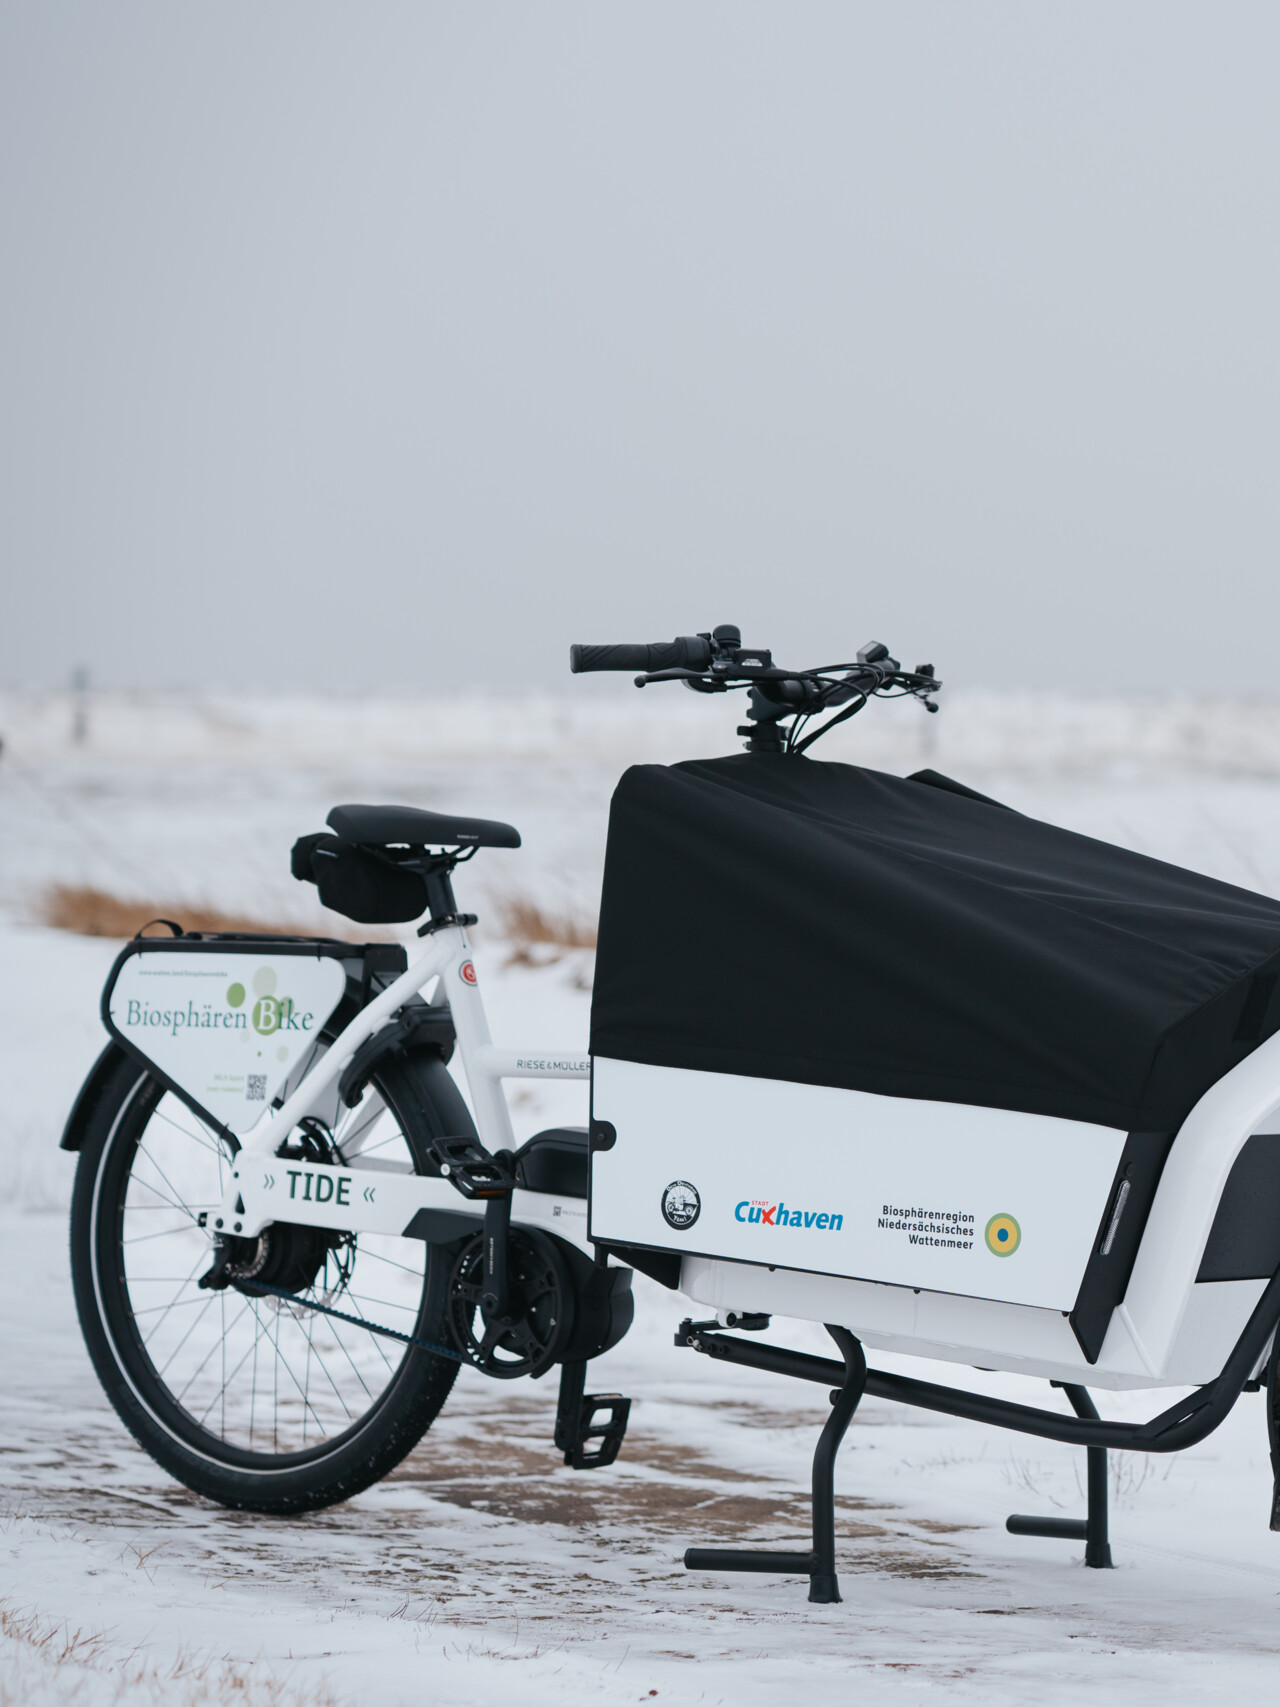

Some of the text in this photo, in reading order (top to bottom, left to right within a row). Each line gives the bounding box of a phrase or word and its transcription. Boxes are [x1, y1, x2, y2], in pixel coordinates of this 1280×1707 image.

[126, 997, 314, 1036] Biosphären Bike
[286, 1170, 352, 1206] TIDE
[734, 1200, 844, 1231] Cuxhaven
[877, 1218, 974, 1236] Niedersächsisches
[882, 1205, 975, 1224] Biosphärenregion
[908, 1234, 974, 1249] Wattenmeer
